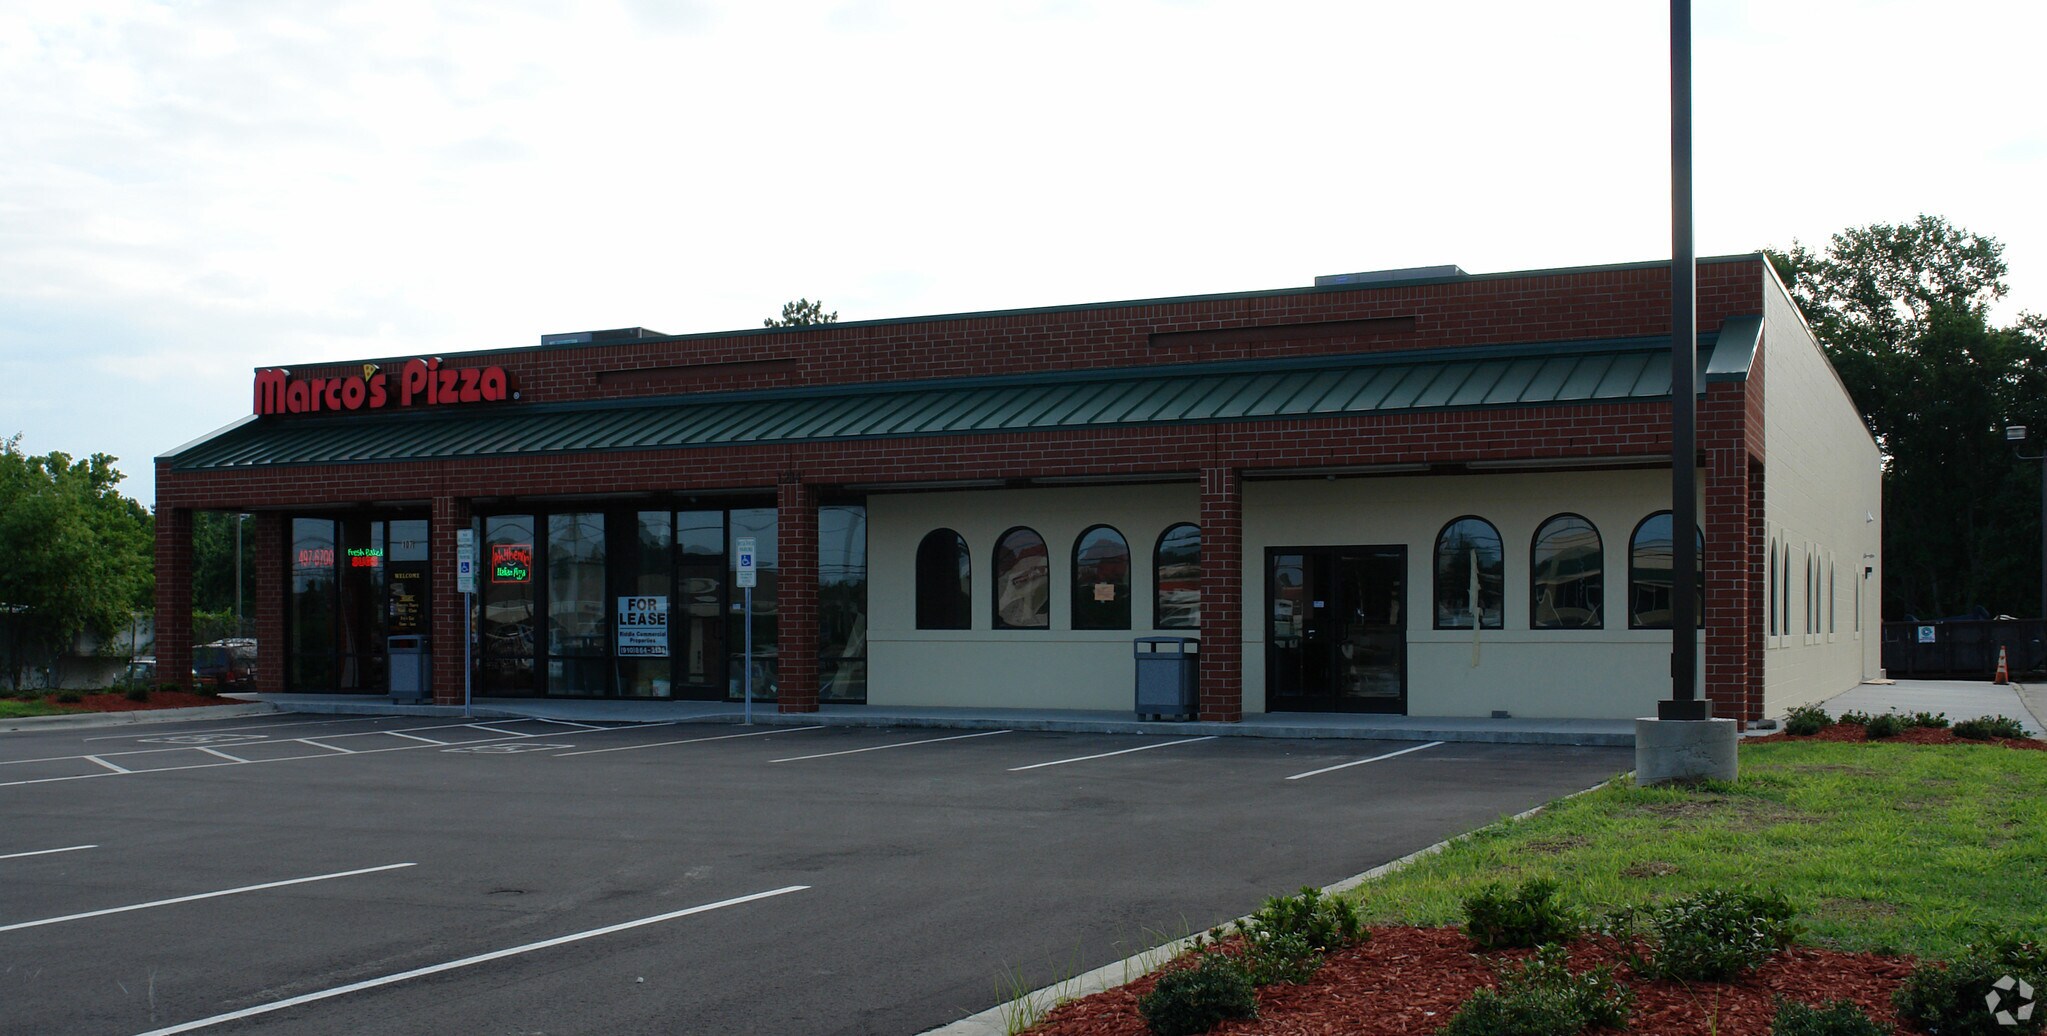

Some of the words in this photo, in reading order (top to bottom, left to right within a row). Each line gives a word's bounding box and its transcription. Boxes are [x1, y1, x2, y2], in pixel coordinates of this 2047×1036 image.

[254, 363, 387, 415] Marco's
[401, 357, 507, 407] Pizza
[347, 548, 365, 556] Fresh
[628, 598, 657, 611] FOR
[619, 613, 666, 625] LEASE
